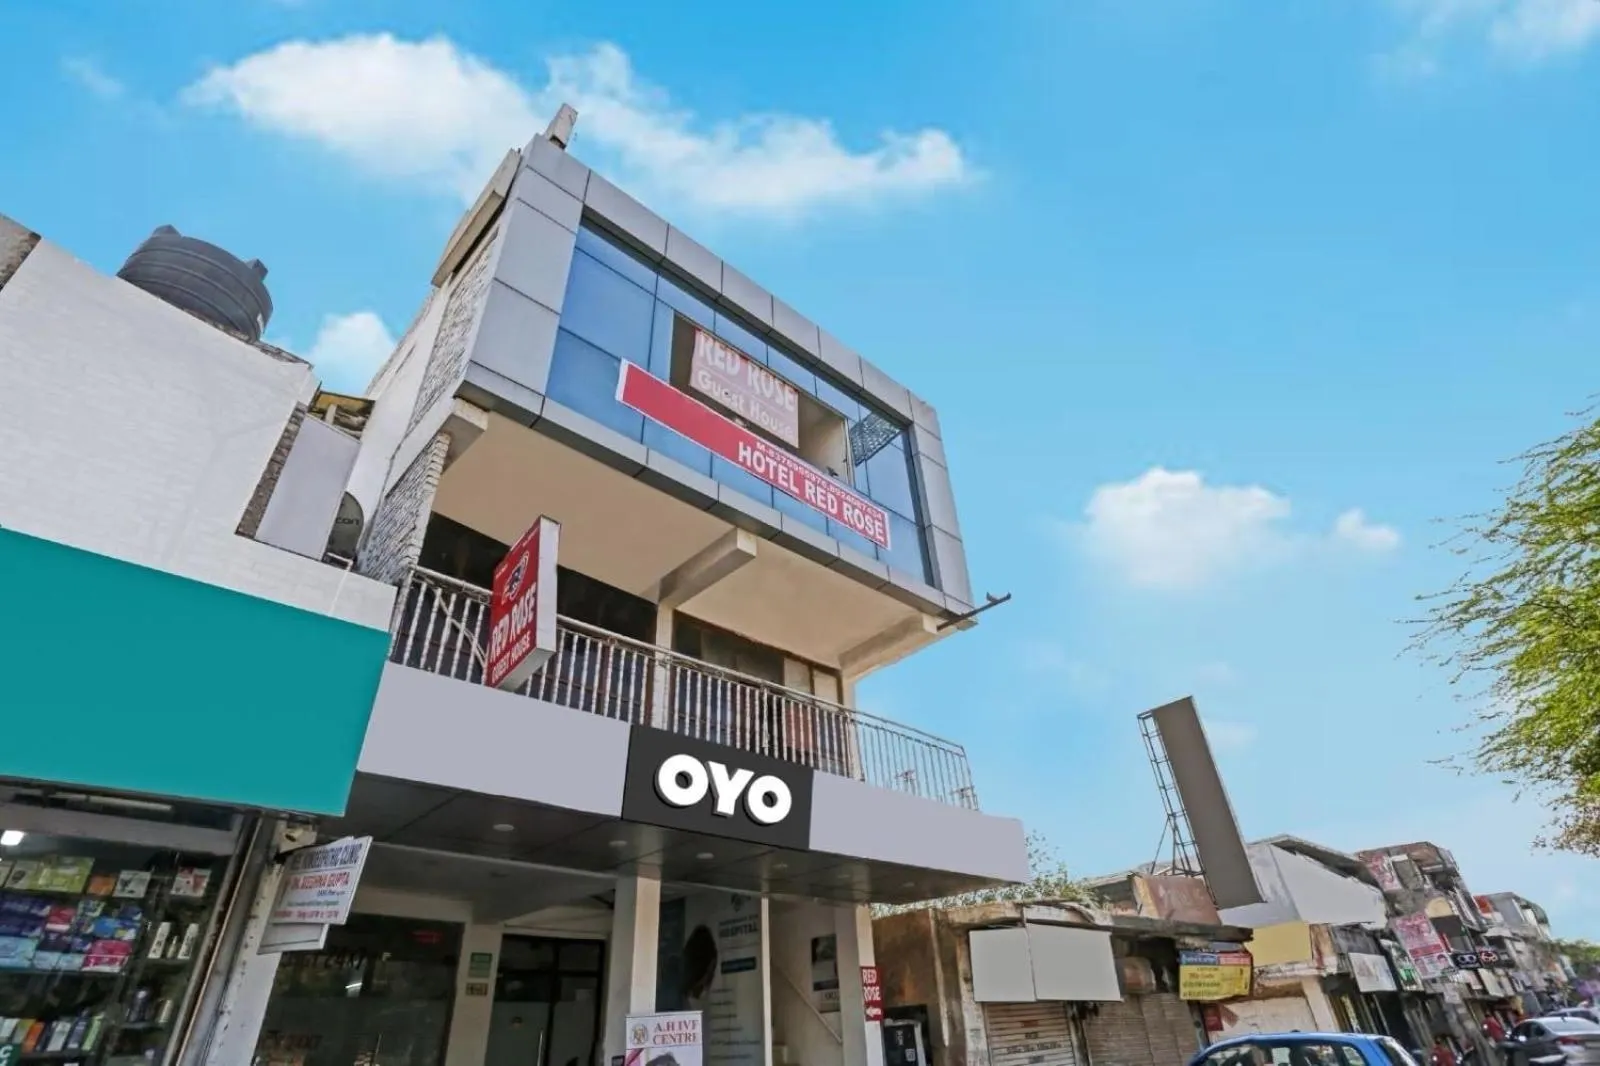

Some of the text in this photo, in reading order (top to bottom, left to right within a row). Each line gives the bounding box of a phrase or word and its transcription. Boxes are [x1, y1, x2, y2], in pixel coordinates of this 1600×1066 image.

[700, 332, 796, 412] RED ROSE
[739, 441, 885, 542] HOTEL RED ROSE
[490, 590, 534, 663] RED ROSE
[653, 753, 793, 825] OYO
[862, 968, 877, 984] RED
[863, 986, 881, 1002] ROSE
[653, 1032, 697, 1045] CENTRE
